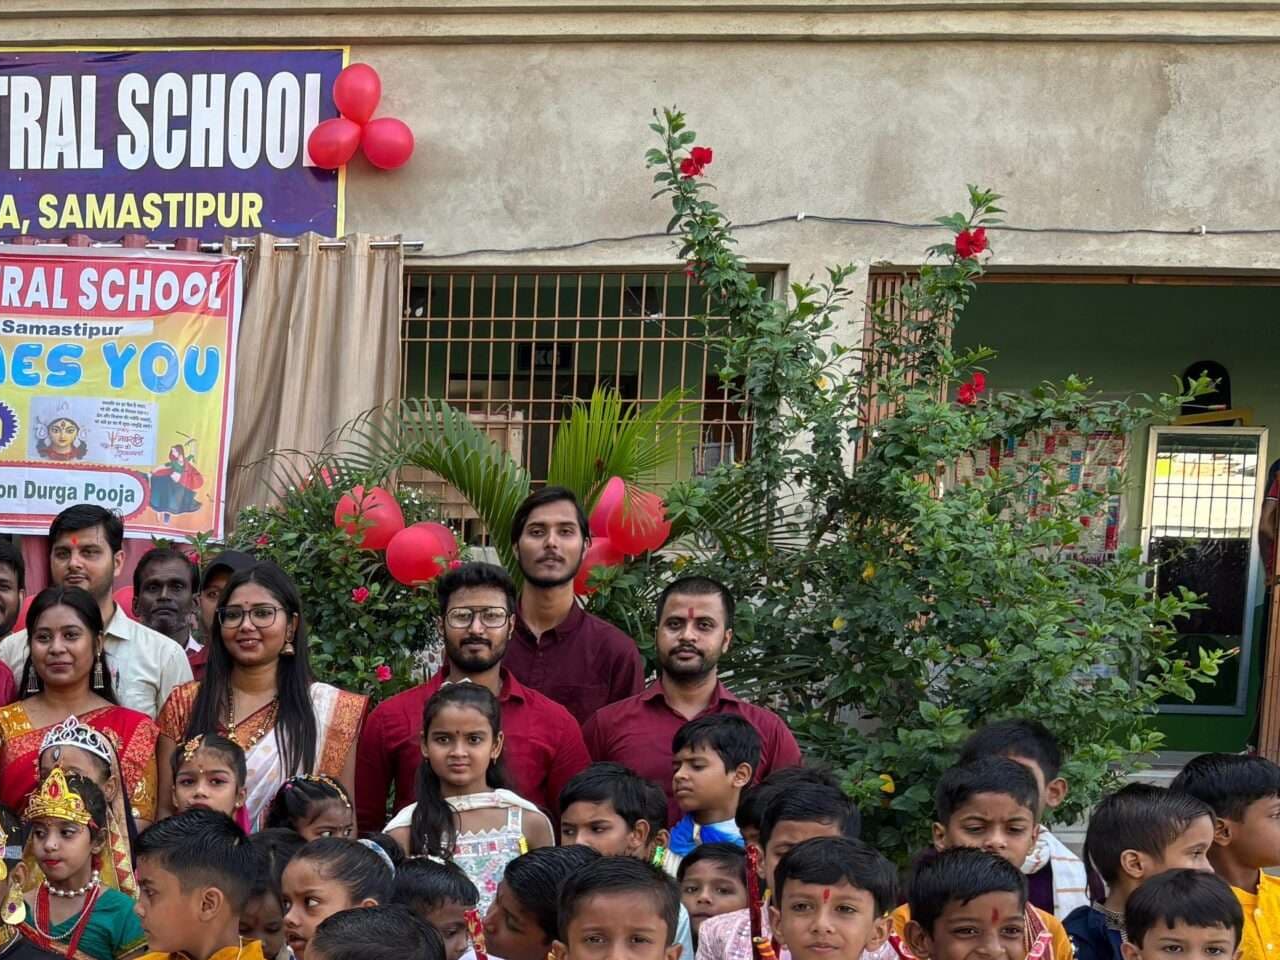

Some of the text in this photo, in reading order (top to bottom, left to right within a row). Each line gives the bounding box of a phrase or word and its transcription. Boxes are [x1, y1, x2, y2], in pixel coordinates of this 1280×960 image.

[117, 71, 322, 170] SCHOOL
[38, 192, 263, 230] SAMASTIPUR
[78, 267, 222, 312] SCHOOL
[1, 319, 124, 340] Samastipur
[101, 340, 222, 395] YOU
[23, 480, 77, 505] Durga
[84, 483, 135, 507] Pooja
